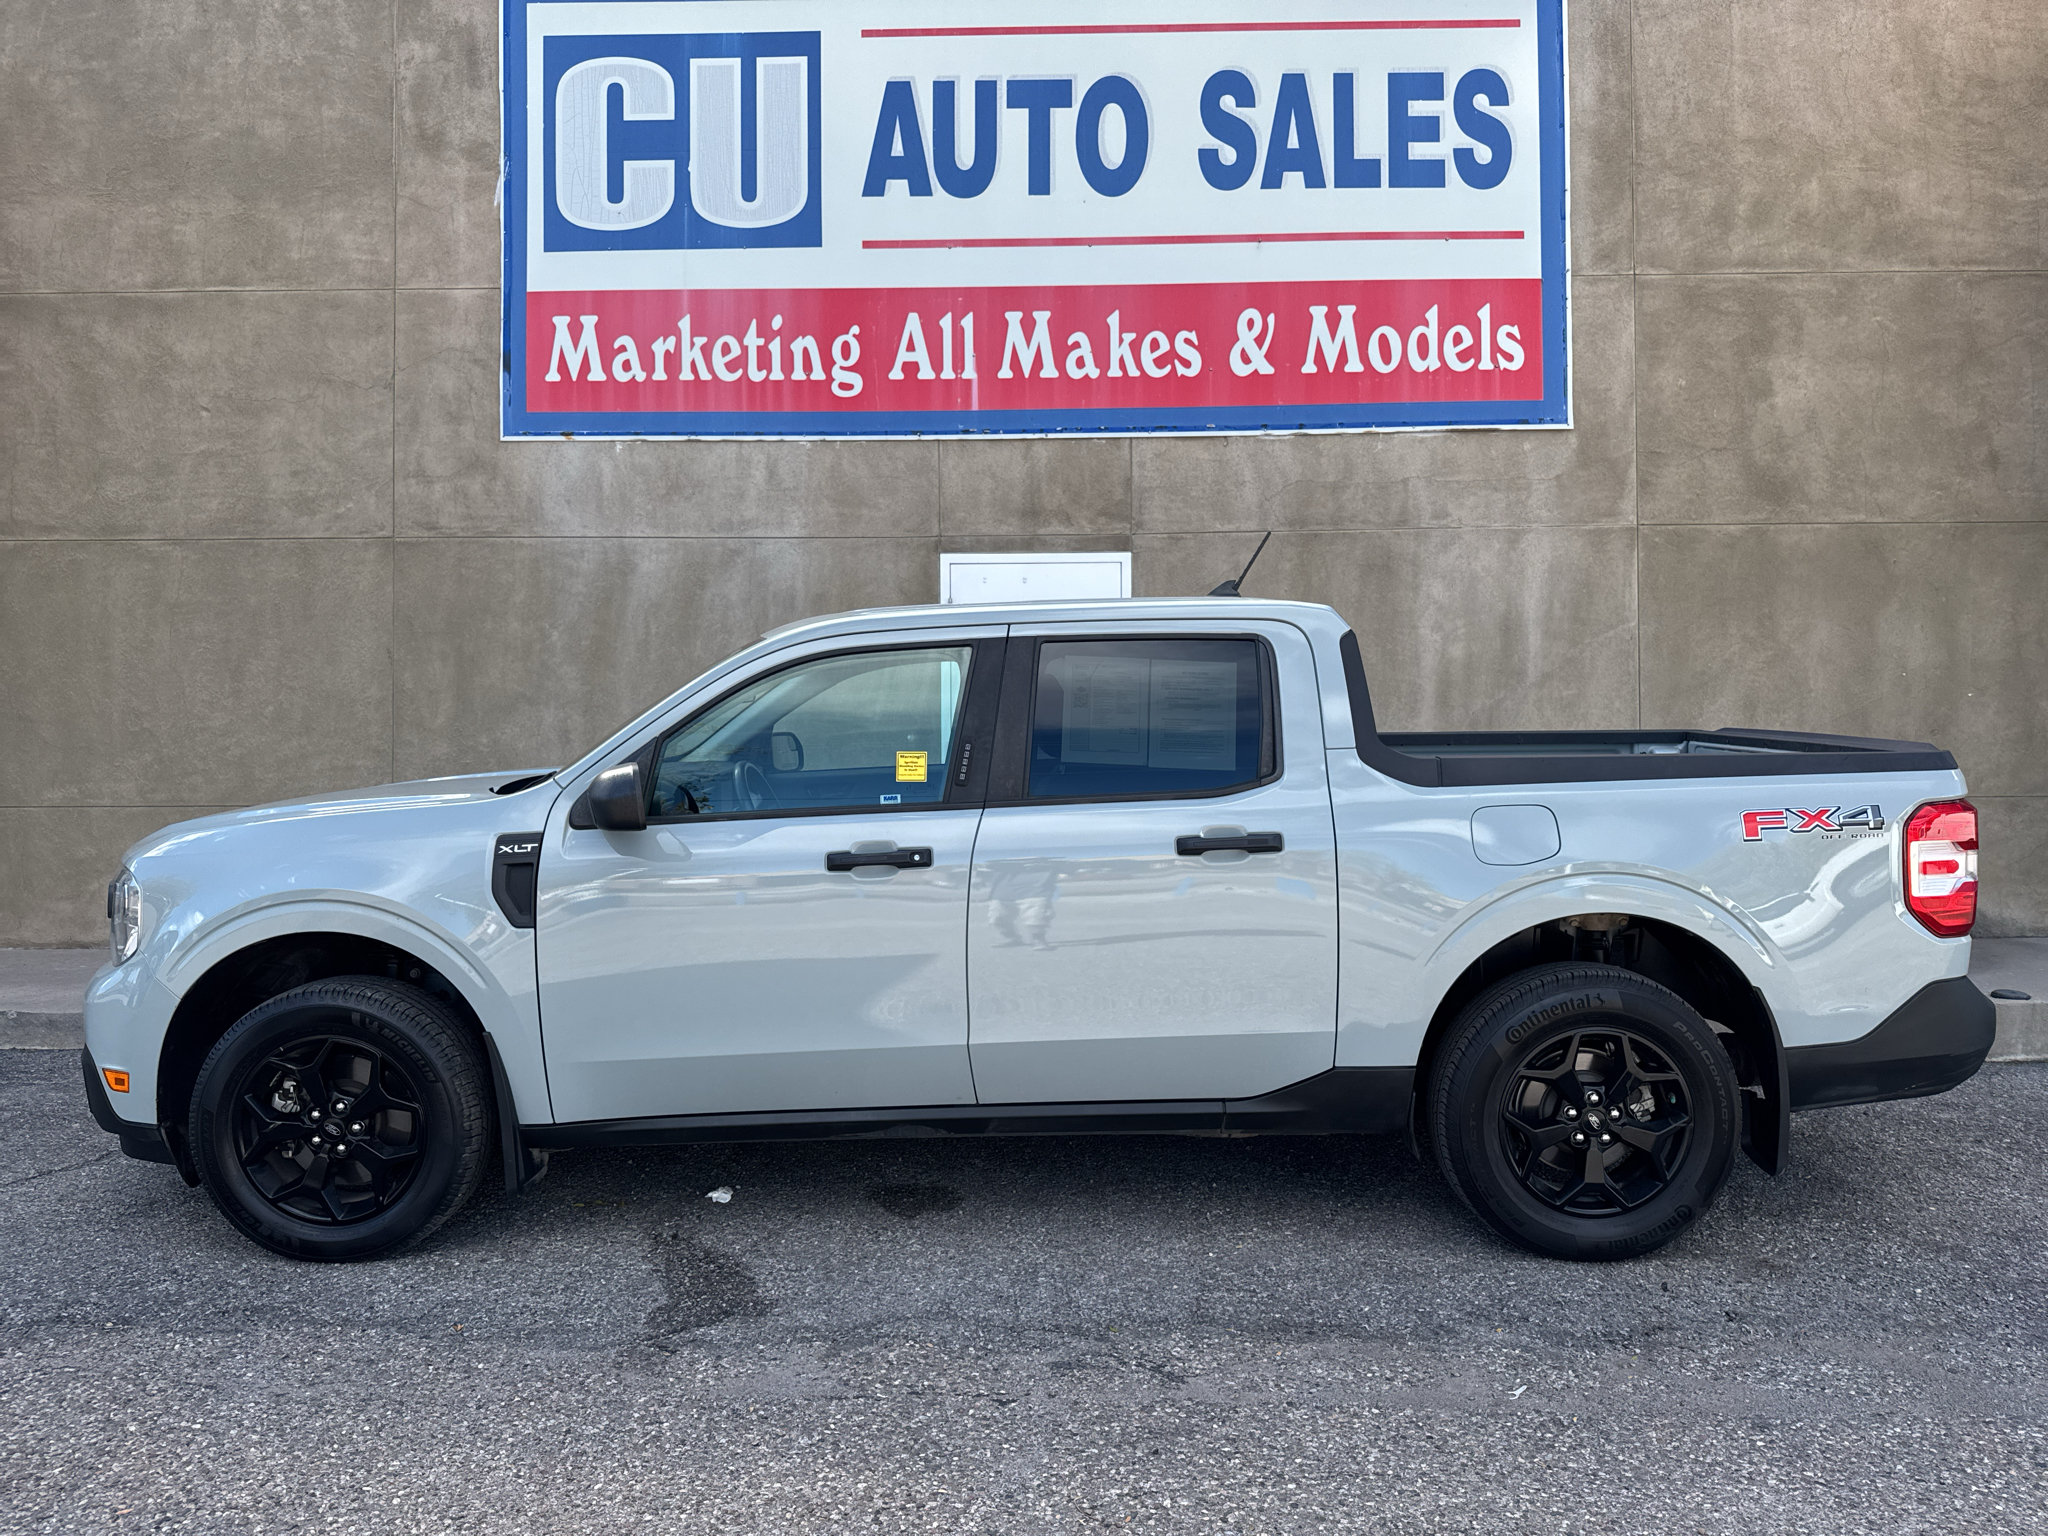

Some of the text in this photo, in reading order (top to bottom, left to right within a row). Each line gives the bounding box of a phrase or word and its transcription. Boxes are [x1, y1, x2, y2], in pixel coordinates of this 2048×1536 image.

[555, 56, 809, 231] CU
[861, 68, 1514, 199] AUTO SALES
[544, 303, 1525, 398] Marketing All Makes & Models
[498, 843, 539, 854] XLT
[1739, 804, 1886, 843] FX4
[1504, 993, 1592, 1046] Continental
[379, 1026, 438, 1084] MICHELIN
[1609, 1203, 1693, 1254] Continental
